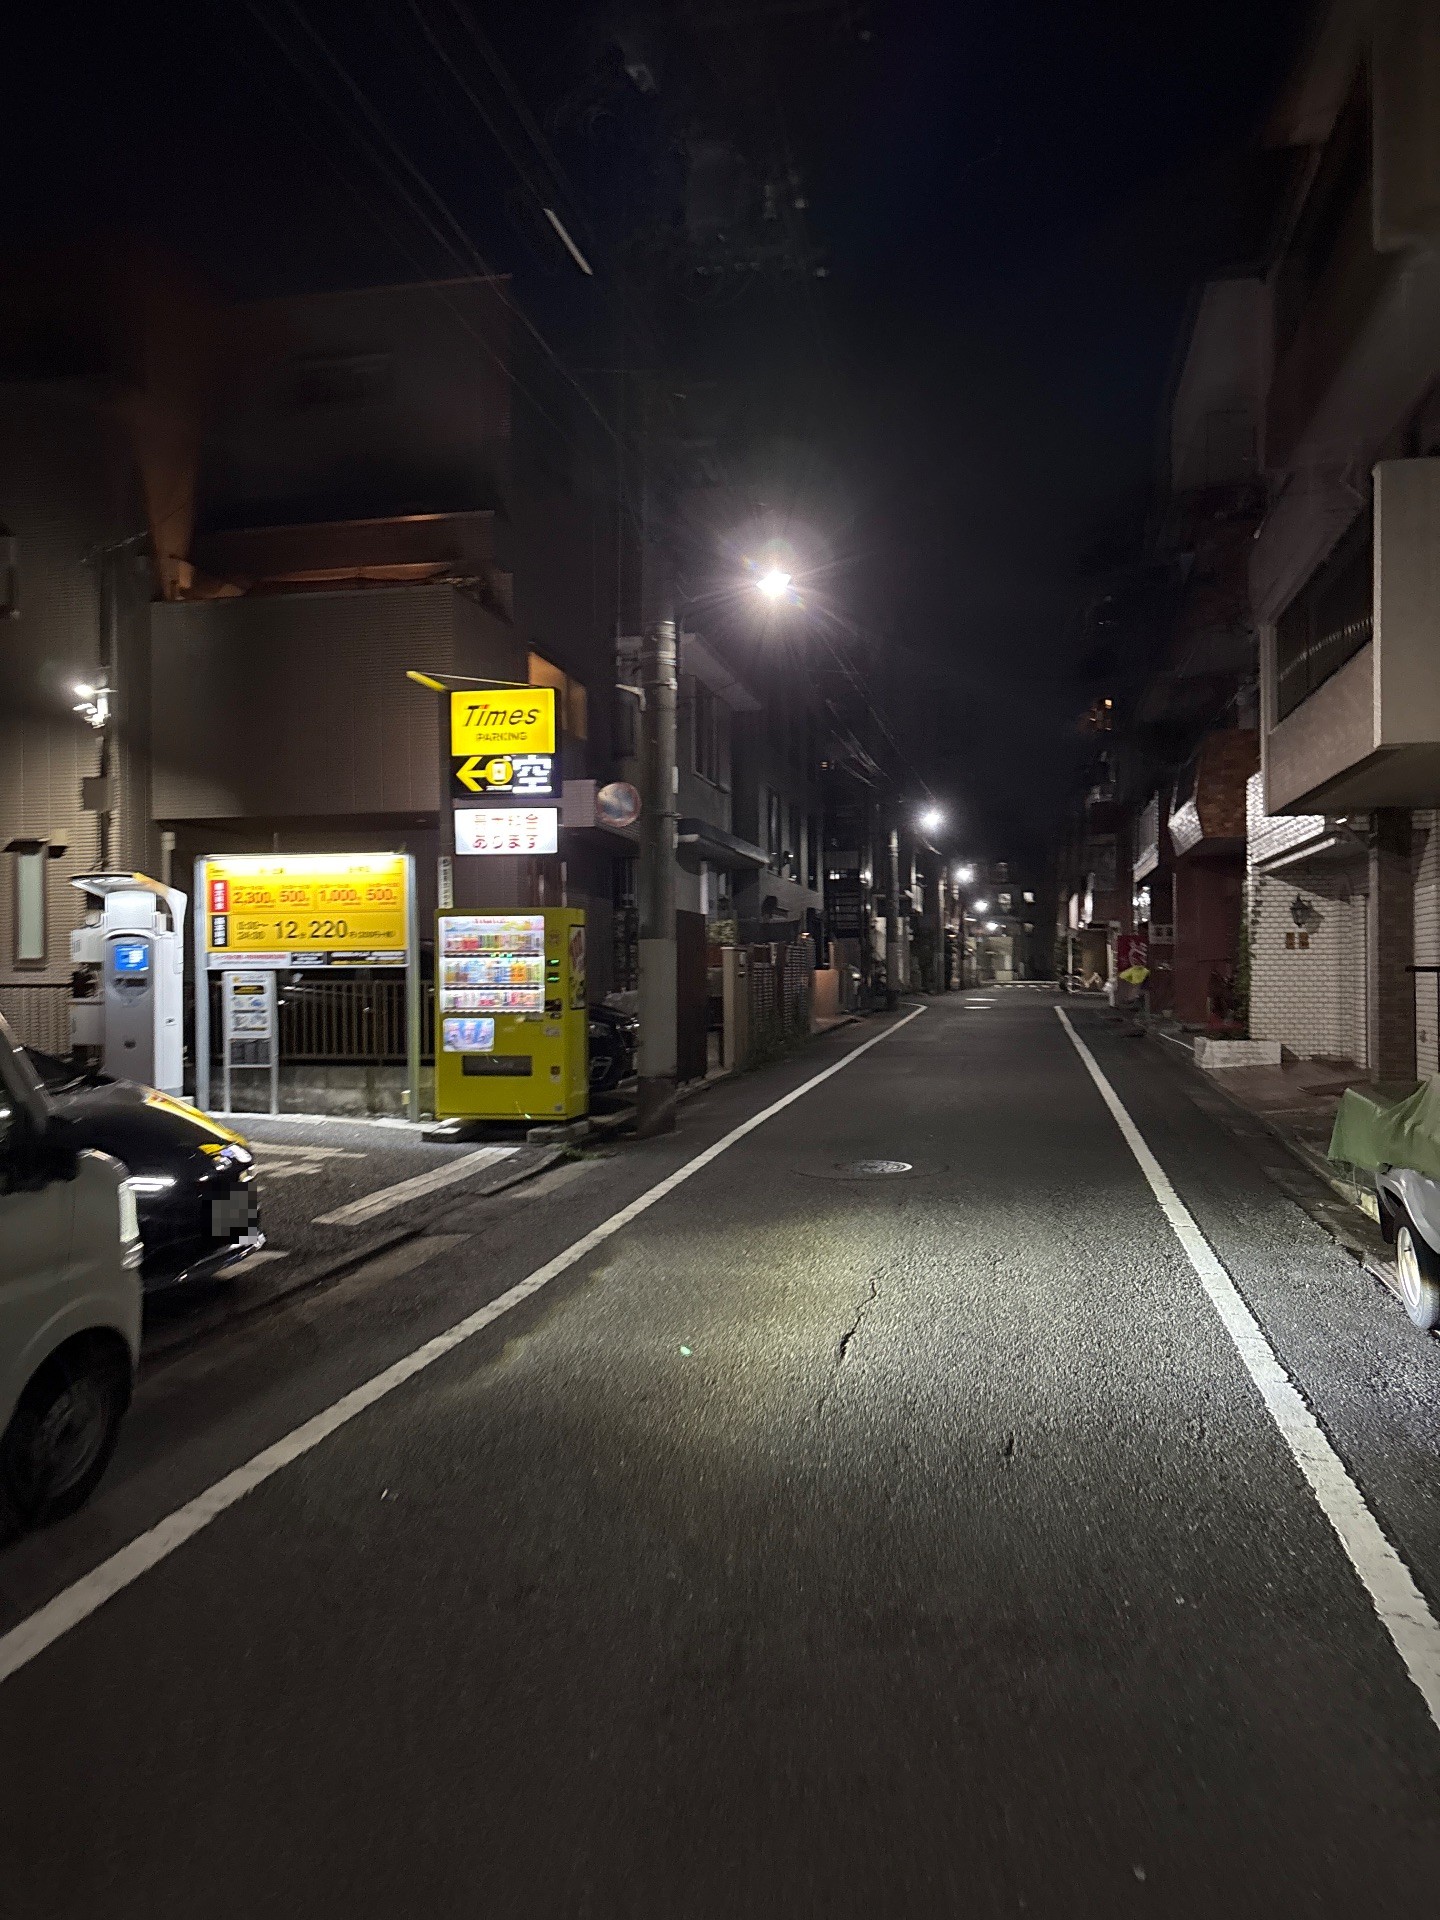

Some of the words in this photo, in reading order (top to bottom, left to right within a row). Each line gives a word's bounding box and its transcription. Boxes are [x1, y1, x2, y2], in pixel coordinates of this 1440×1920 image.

[463, 704, 541, 727] Times
[476, 731, 528, 741] PARKING
[511, 754, 553, 794] 空
[233, 891, 275, 904] 2,300
[280, 890, 309, 903] 500
[319, 889, 361, 903] 1,000
[367, 888, 397, 901] 500
